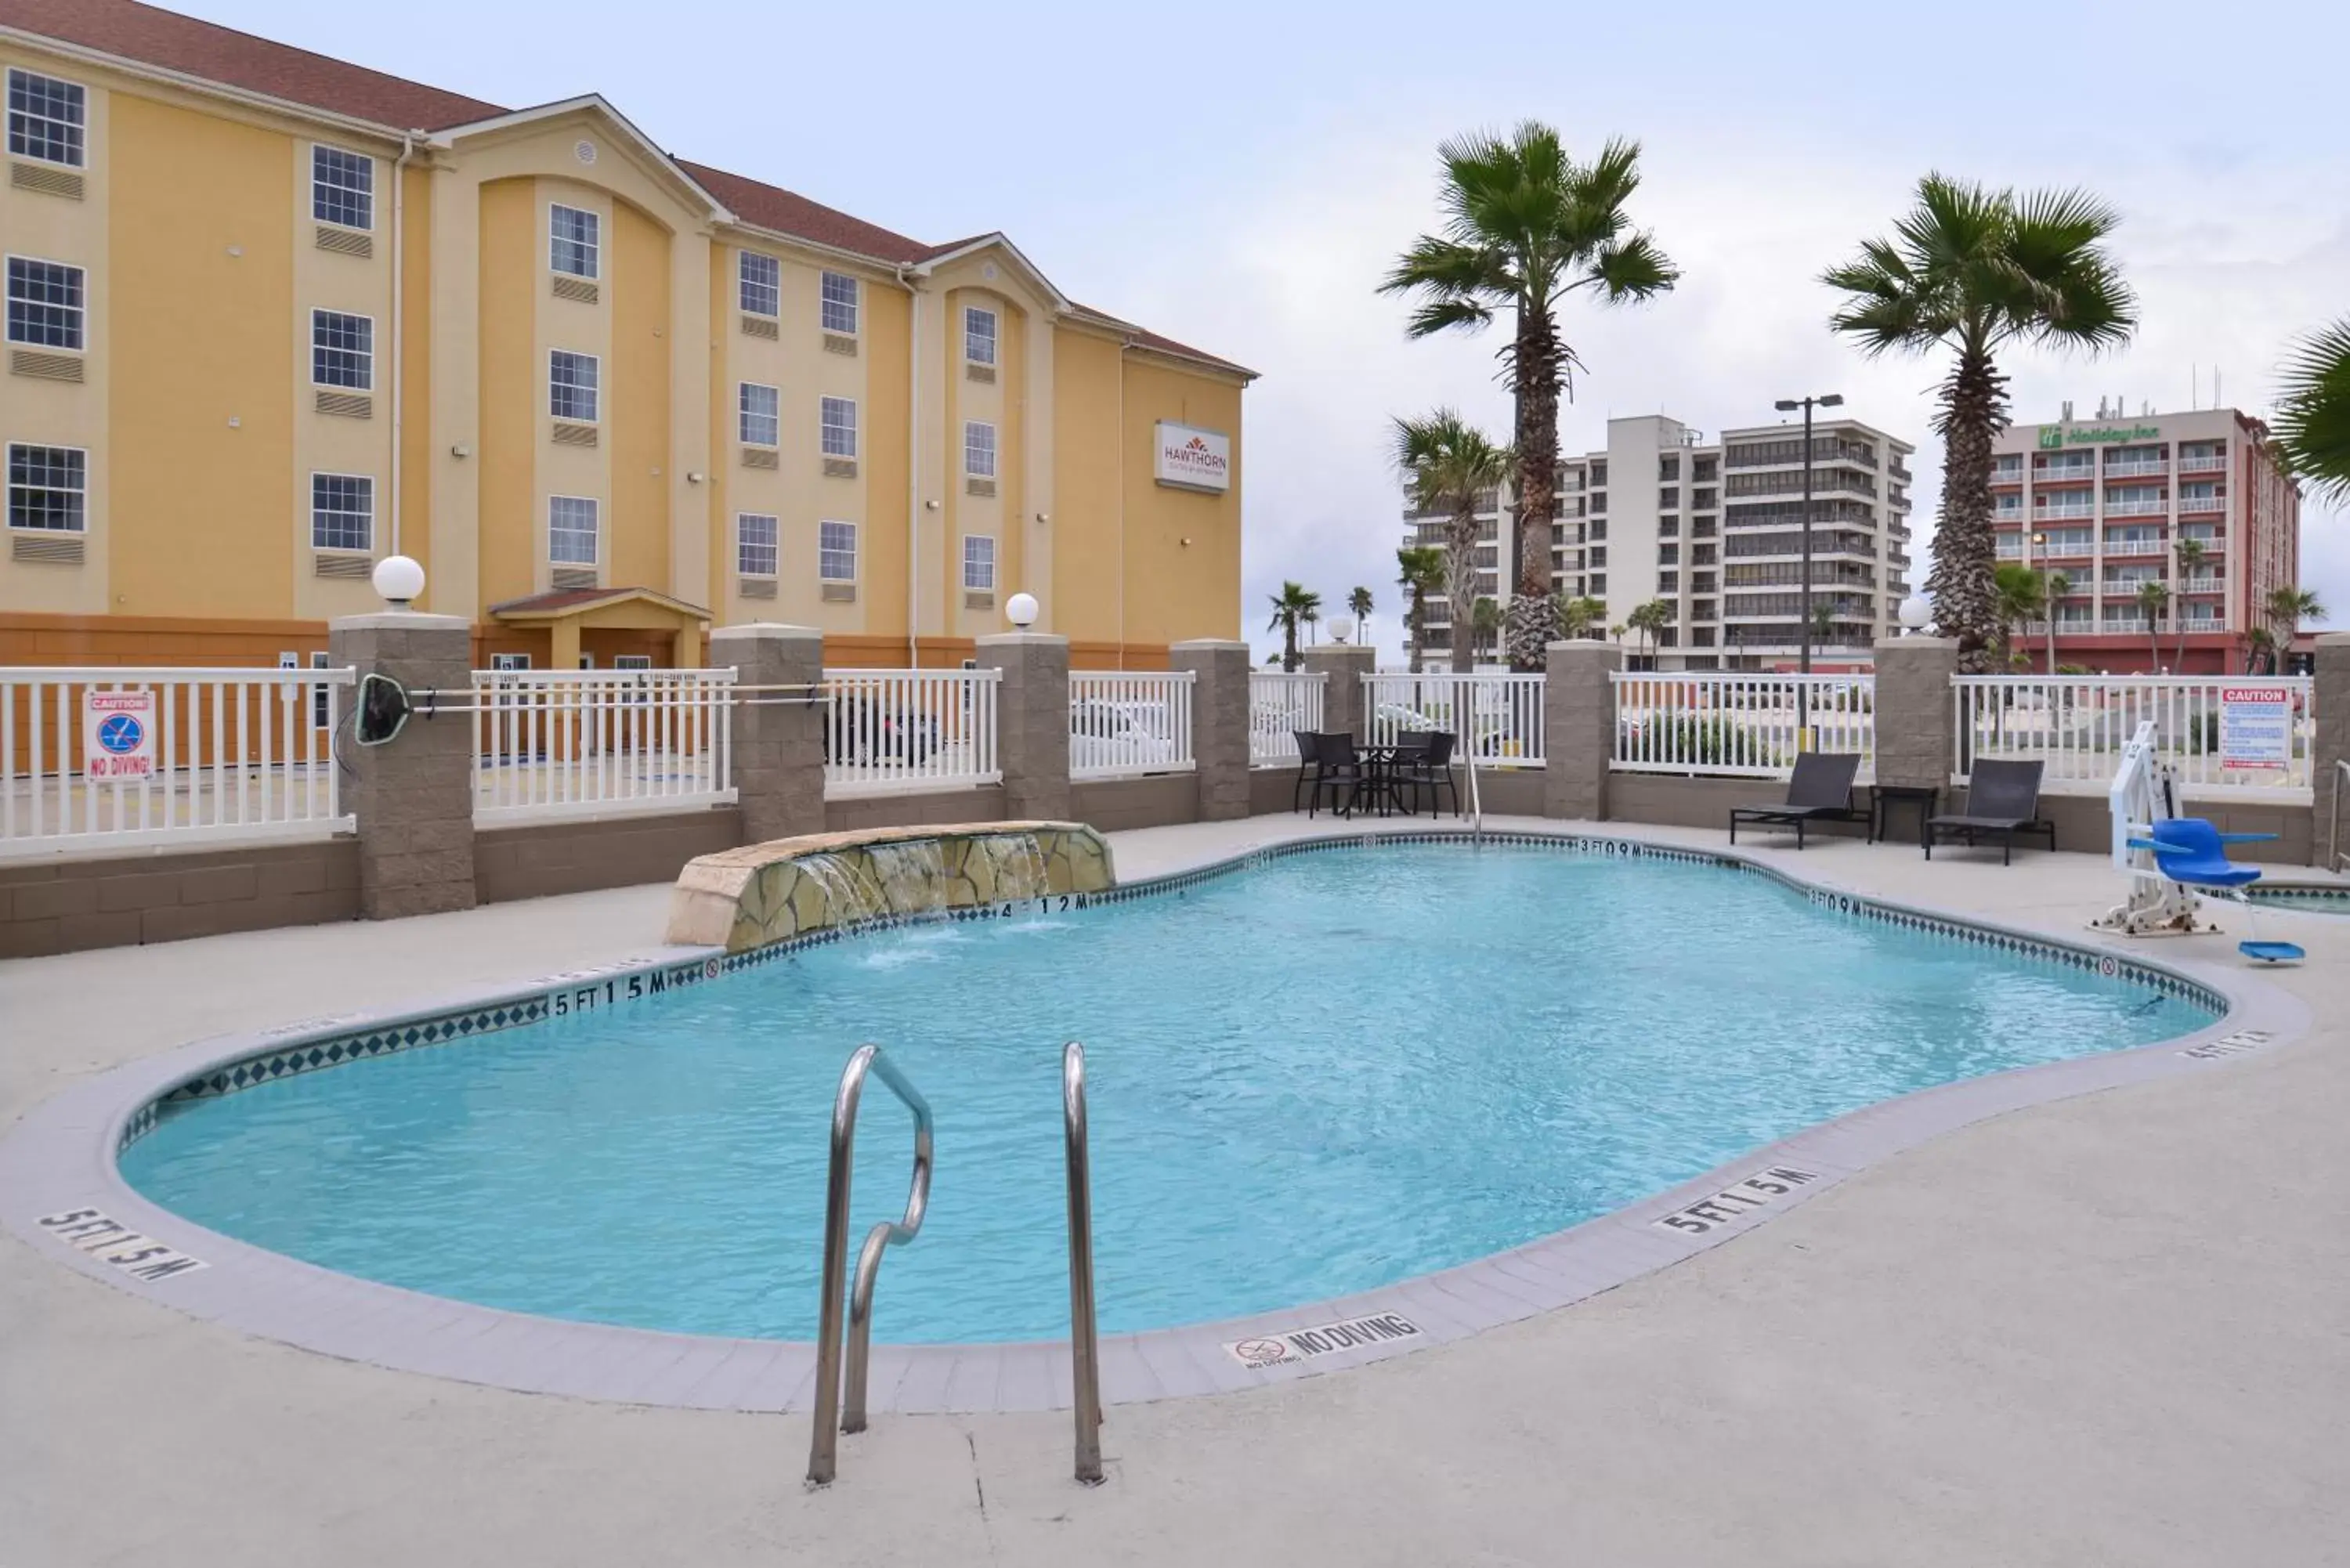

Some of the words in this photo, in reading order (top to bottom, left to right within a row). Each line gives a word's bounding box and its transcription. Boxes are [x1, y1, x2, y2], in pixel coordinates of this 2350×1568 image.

[1165, 446, 1227, 470] HAWTHORN
[2226, 690, 2283, 702] CAUTION
[91, 758, 106, 776] NO
[1287, 1331, 1333, 1355] NO
[1325, 1315, 1419, 1348] DIVING
